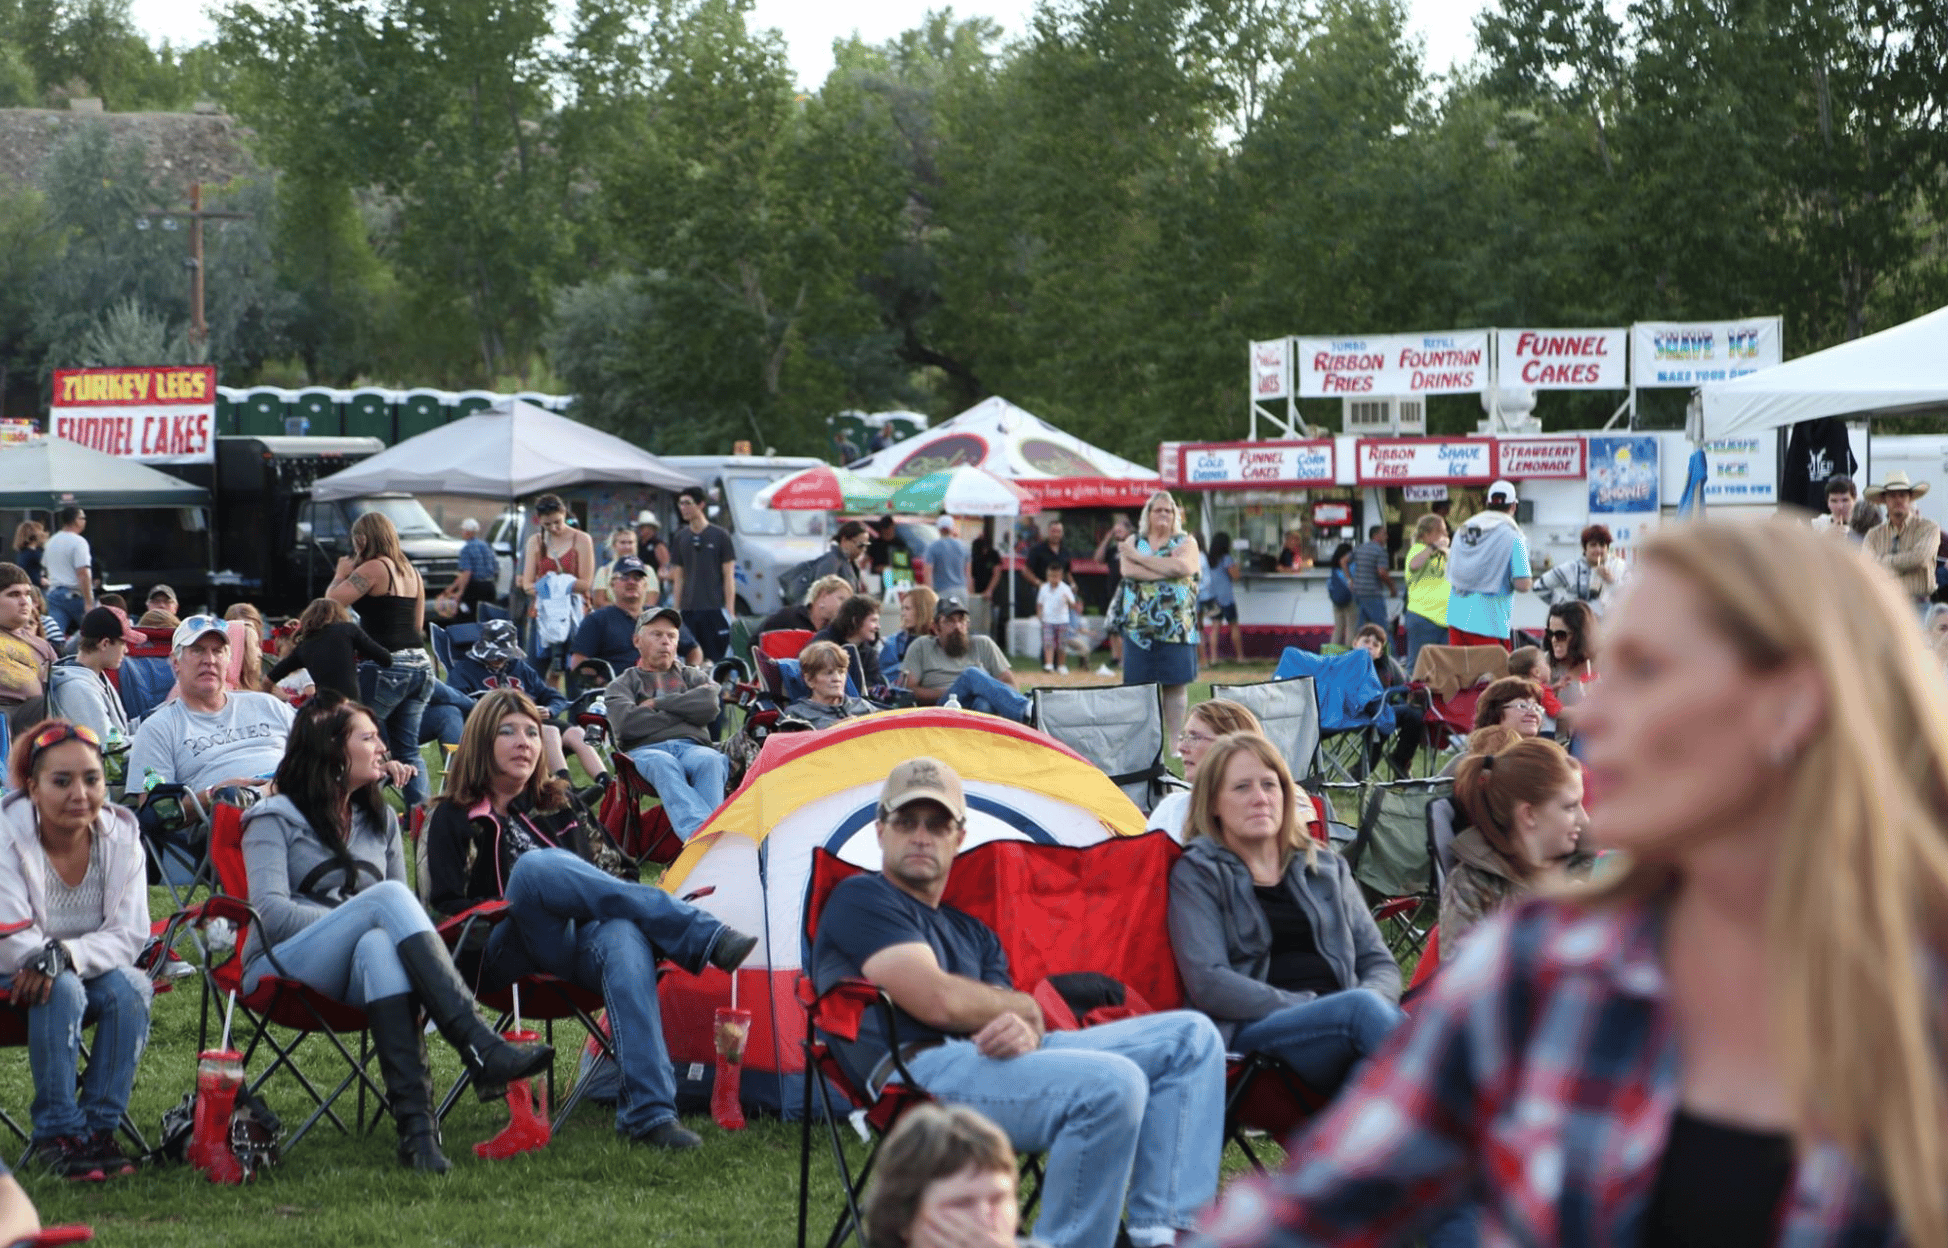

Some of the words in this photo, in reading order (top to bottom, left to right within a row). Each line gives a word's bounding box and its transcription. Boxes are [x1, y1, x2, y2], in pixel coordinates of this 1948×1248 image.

[1332, 341, 1367, 351] JUMBO
[1423, 337, 1455, 348] REFILL
[1516, 332, 1607, 357] FUNNEL
[1654, 329, 1714, 360] SHAVE
[1728, 327, 1759, 358] ICE
[1314, 352, 1385, 371] RIBBON
[1399, 348, 1482, 369] FOUNTAIN
[1522, 360, 1600, 383] CAKES
[1657, 370, 1691, 382] MAKE
[1696, 369, 1727, 381] YOUR
[63, 374, 150, 401] TURKEY
[155, 372, 206, 399] LEGS
[1322, 374, 1374, 392] FRIES
[1410, 371, 1474, 390] DRINKS
[141, 414, 208, 454] CAKES
[1239, 450, 1284, 464] FUNNEL
[1297, 453, 1326, 465] CORN
[1369, 446, 1415, 460] RIBBON
[1438, 444, 1480, 460] SHAVE
[1502, 446, 1577, 459] STRAWBERRY
[1242, 466, 1280, 480] CAKES
[1375, 462, 1409, 477] FRIES
[1449, 462, 1469, 476] ICE
[1507, 460, 1571, 473] LEMONADE
[1705, 485, 1722, 494] AKE
[183, 723, 271, 757] ROCKIES
